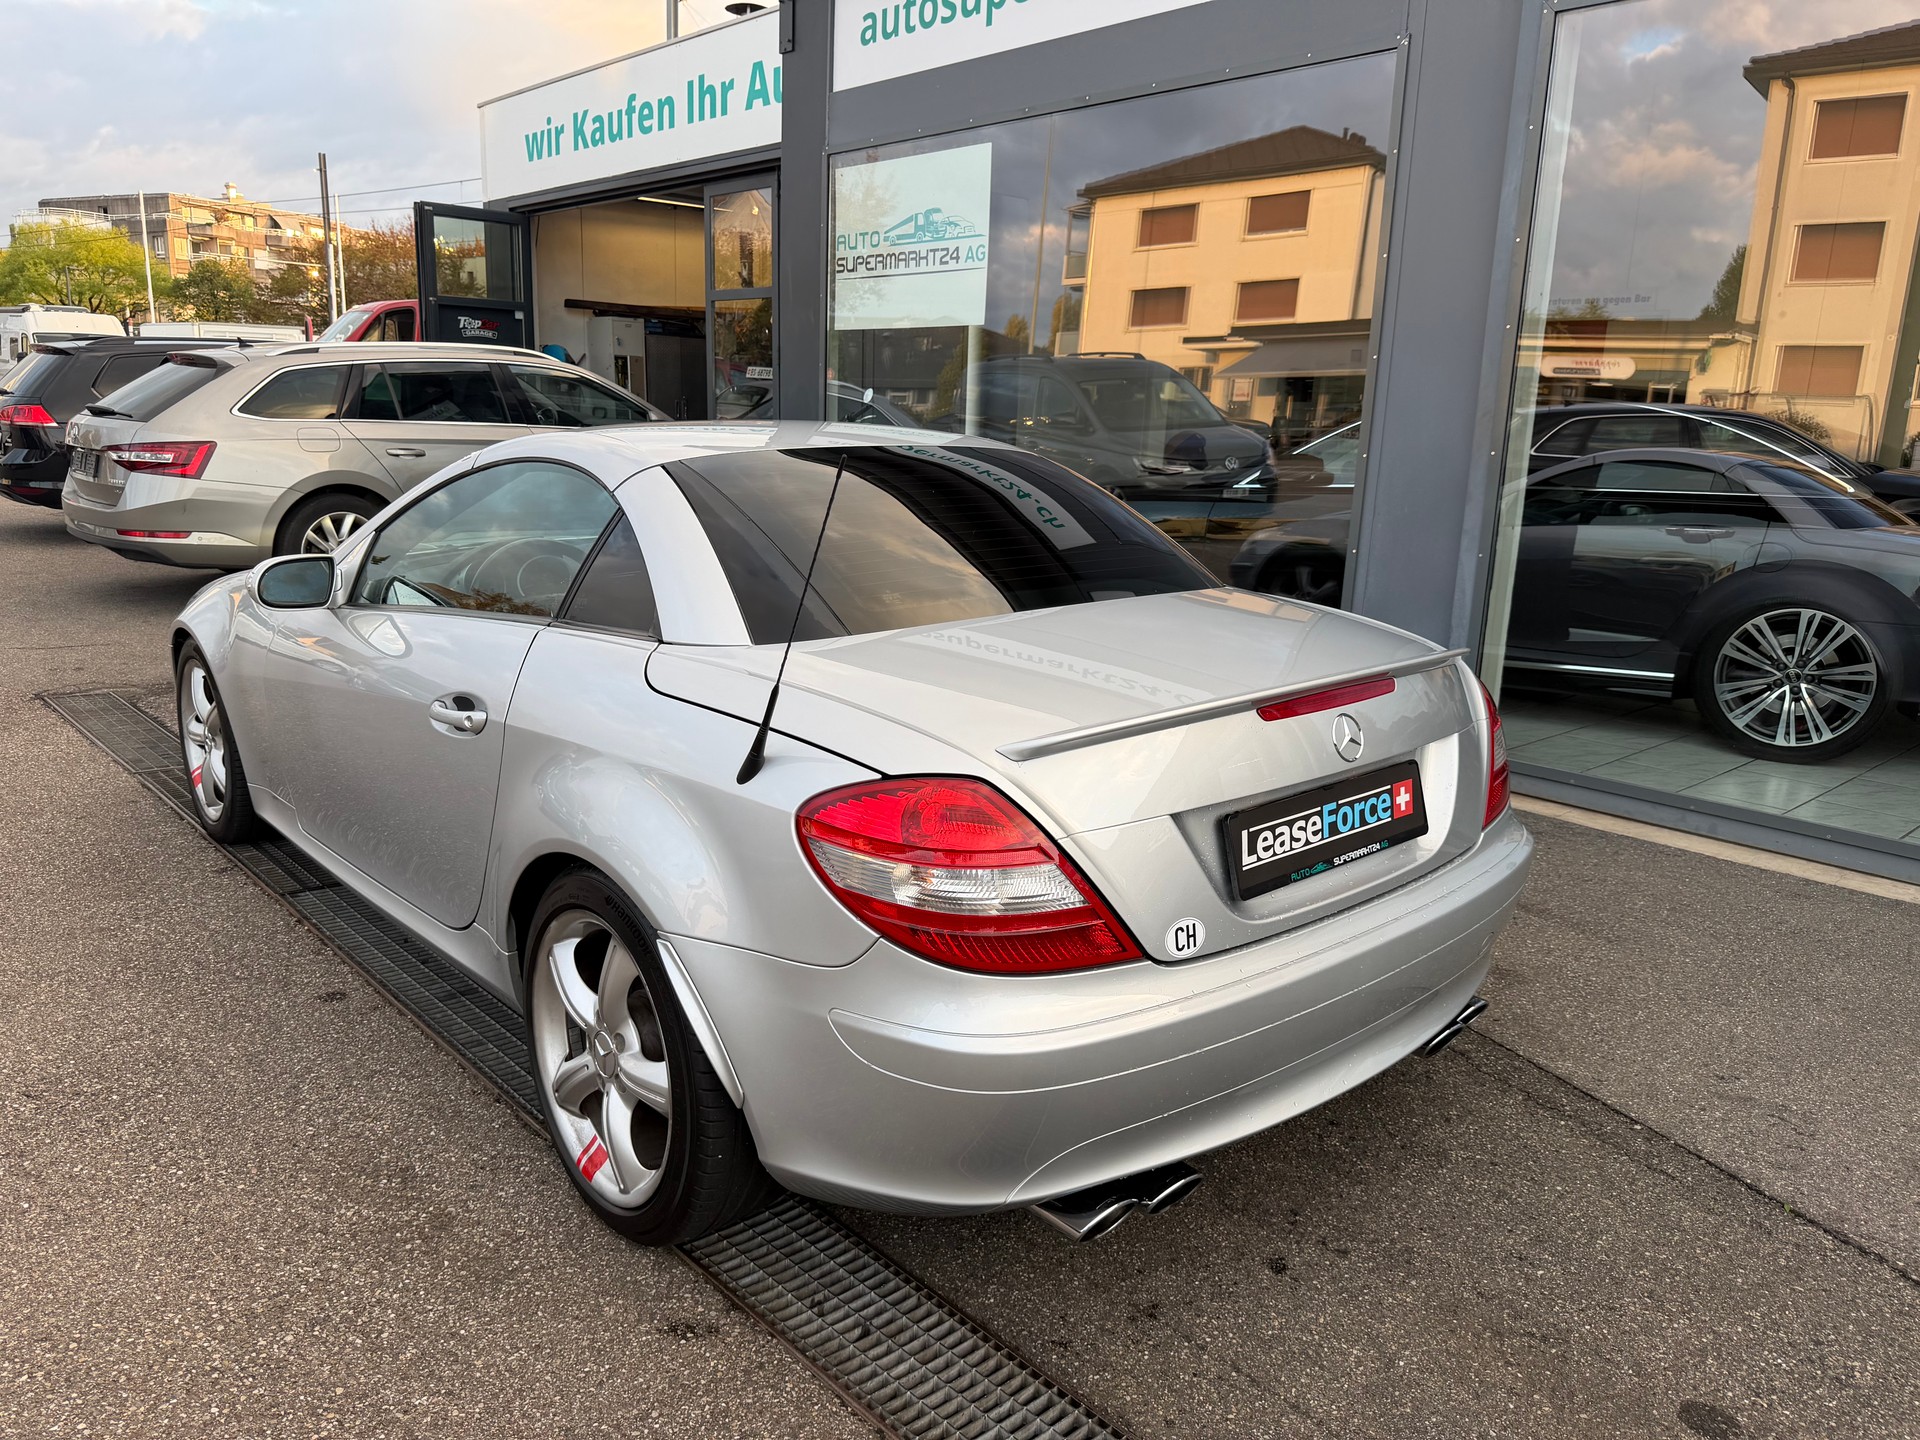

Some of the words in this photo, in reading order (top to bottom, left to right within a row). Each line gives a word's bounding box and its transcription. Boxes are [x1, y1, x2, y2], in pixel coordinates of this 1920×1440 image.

[860, 0, 1028, 46] autosup
[525, 116, 564, 162] wir
[572, 93, 675, 151] Kaufen
[687, 74, 734, 124] Ihr
[836, 246, 960, 274] SUPERMARKT24
[964, 245, 986, 263] AG
[837, 230, 881, 251] AUTO
[1242, 793, 1392, 866] LeaseForce
[1291, 868, 1311, 881] AUTO
[1333, 842, 1381, 866] SUPERMARKT24
[1381, 840, 1389, 848] AG
[1175, 923, 1197, 952] CH
